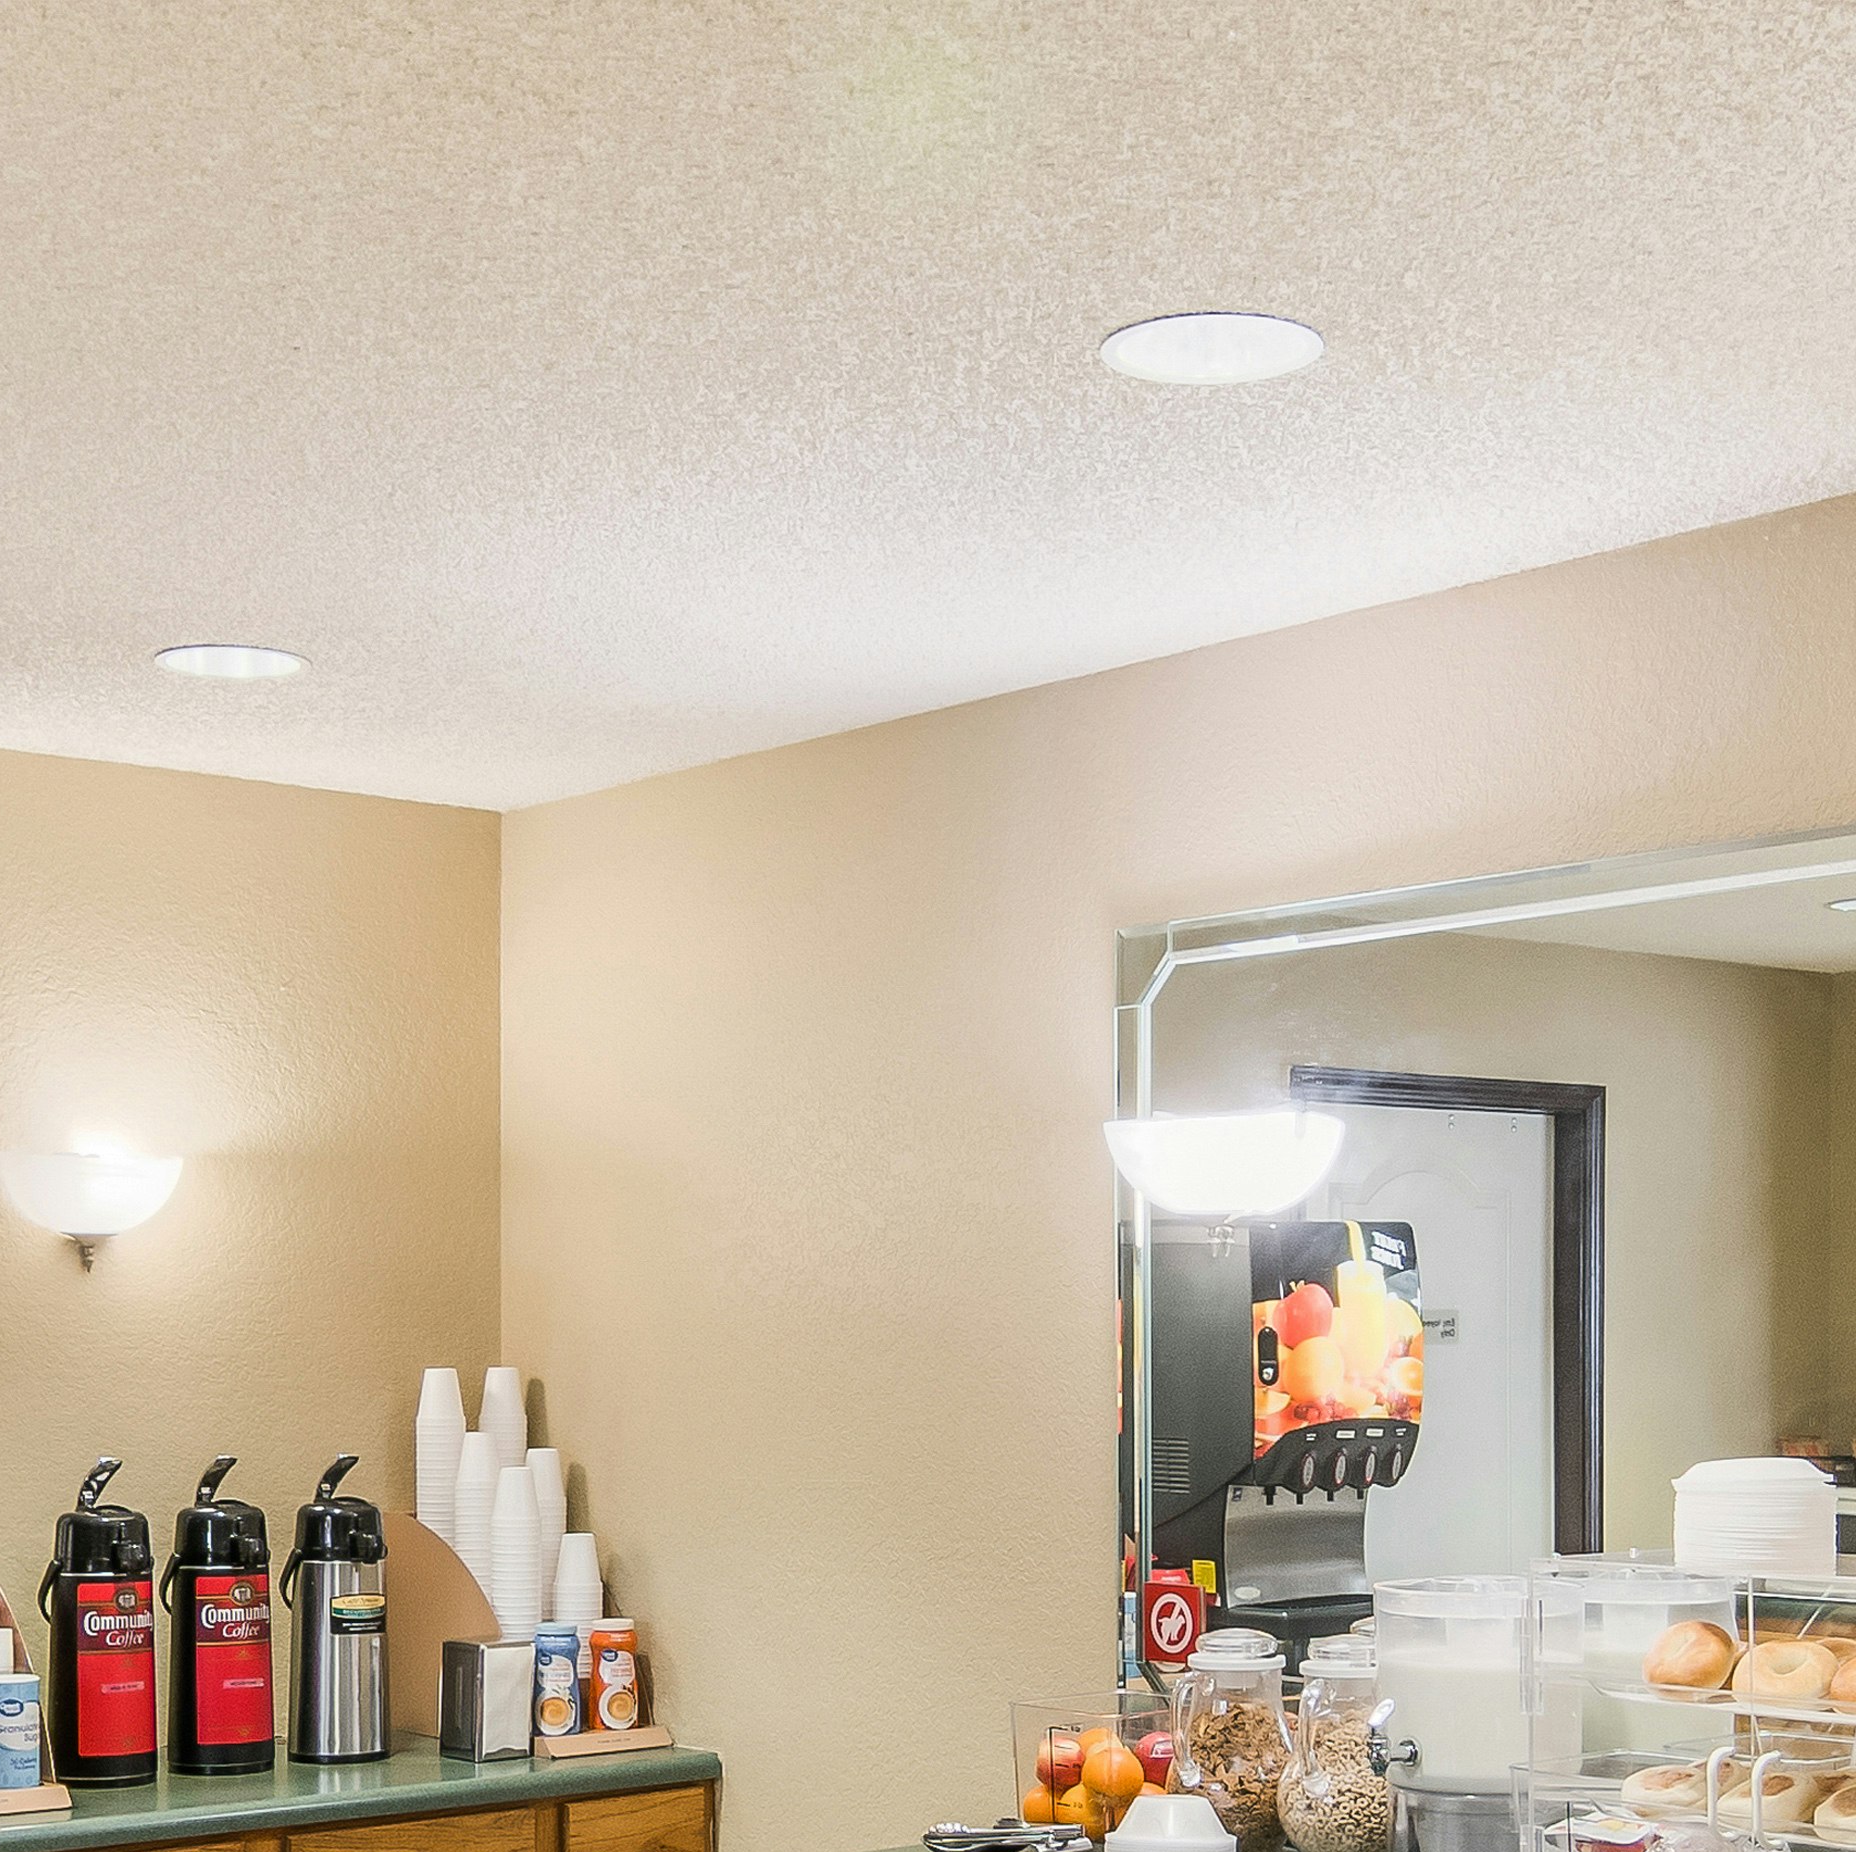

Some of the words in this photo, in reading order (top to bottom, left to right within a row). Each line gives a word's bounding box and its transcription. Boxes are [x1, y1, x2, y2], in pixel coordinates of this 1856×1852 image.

[84, 1610, 153, 1636] Community
[201, 1602, 270, 1629] Community
[106, 1630, 144, 1648] Coffee
[223, 1621, 260, 1639] Coffee
